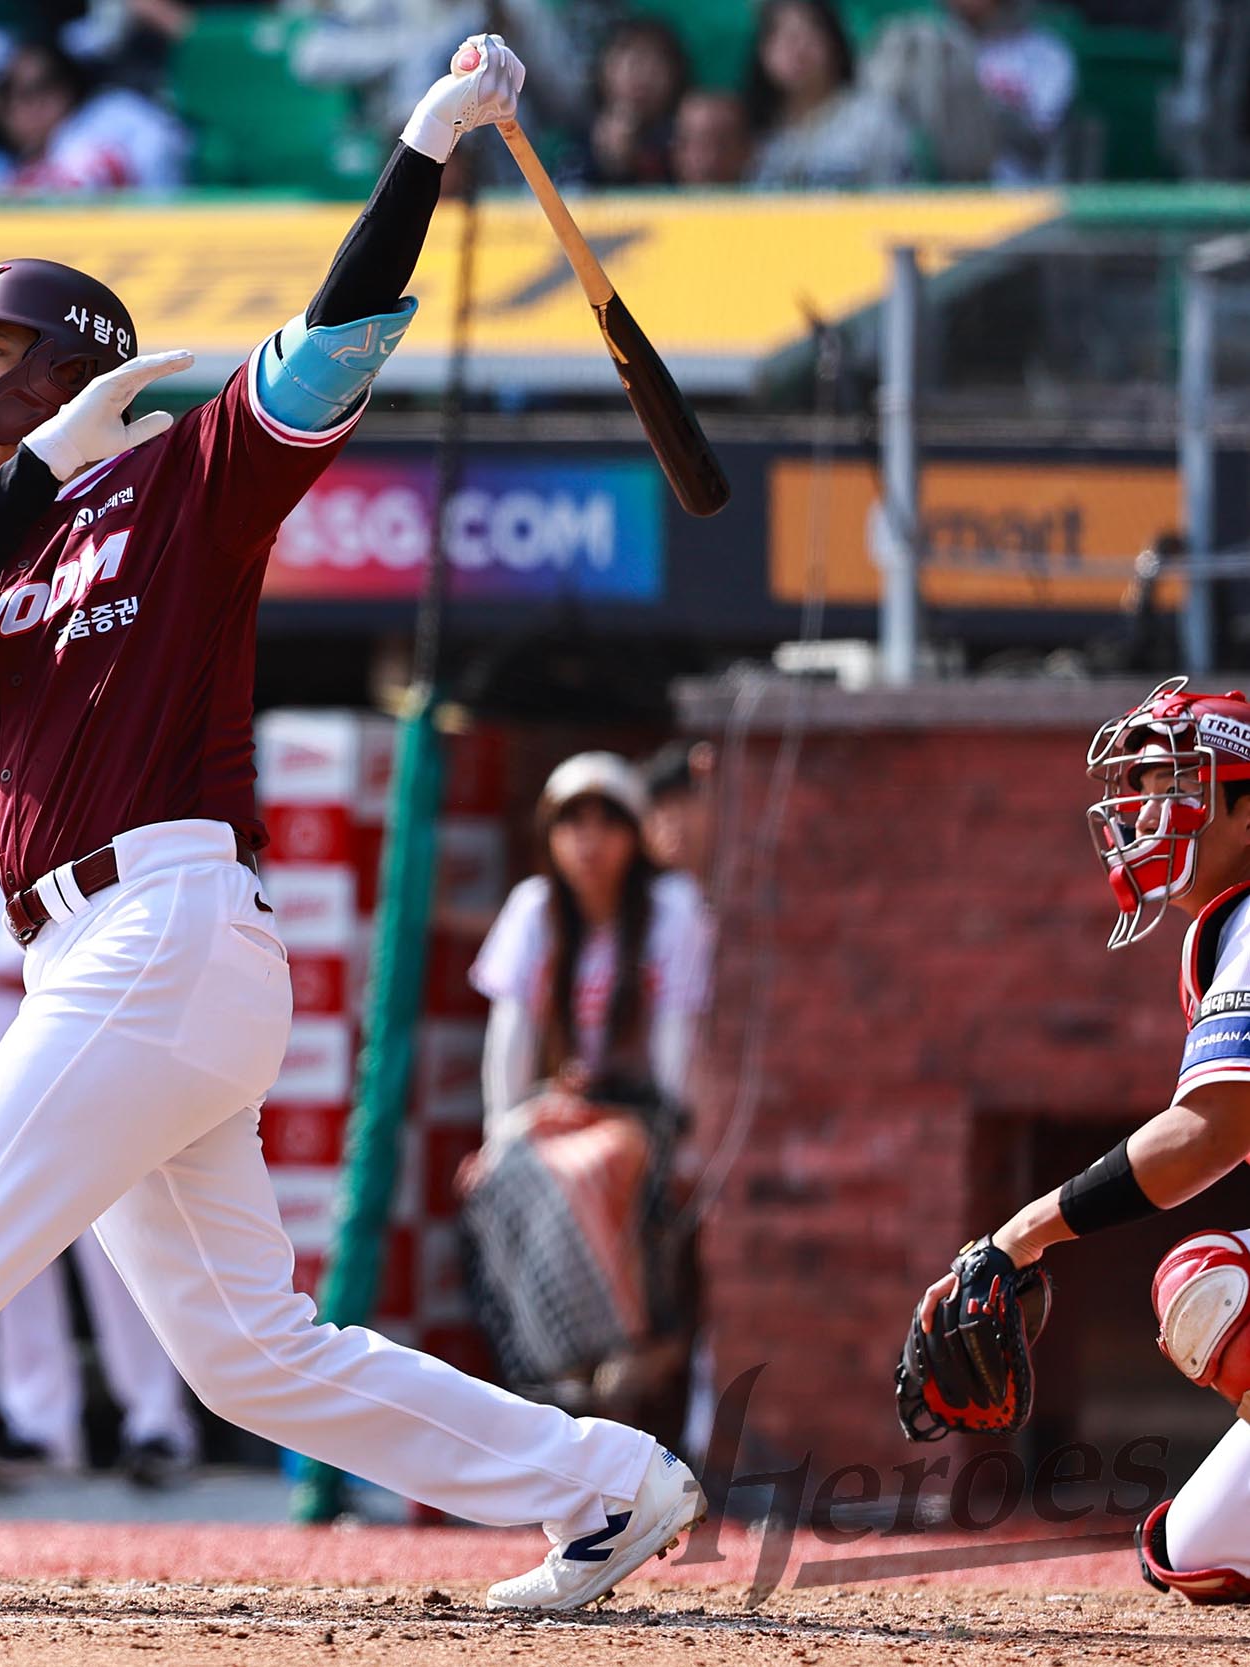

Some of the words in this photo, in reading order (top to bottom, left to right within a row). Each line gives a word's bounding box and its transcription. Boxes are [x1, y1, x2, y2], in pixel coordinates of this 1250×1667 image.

[63, 305, 131, 359] 사람인
[97, 486, 134, 519] 미래엔
[276, 487, 617, 572] SSGCOM
[58, 597, 139, 642] 움증권
[1202, 734, 1250, 757] WHOLESAL
[1195, 1031, 1240, 1049] KOREAN
